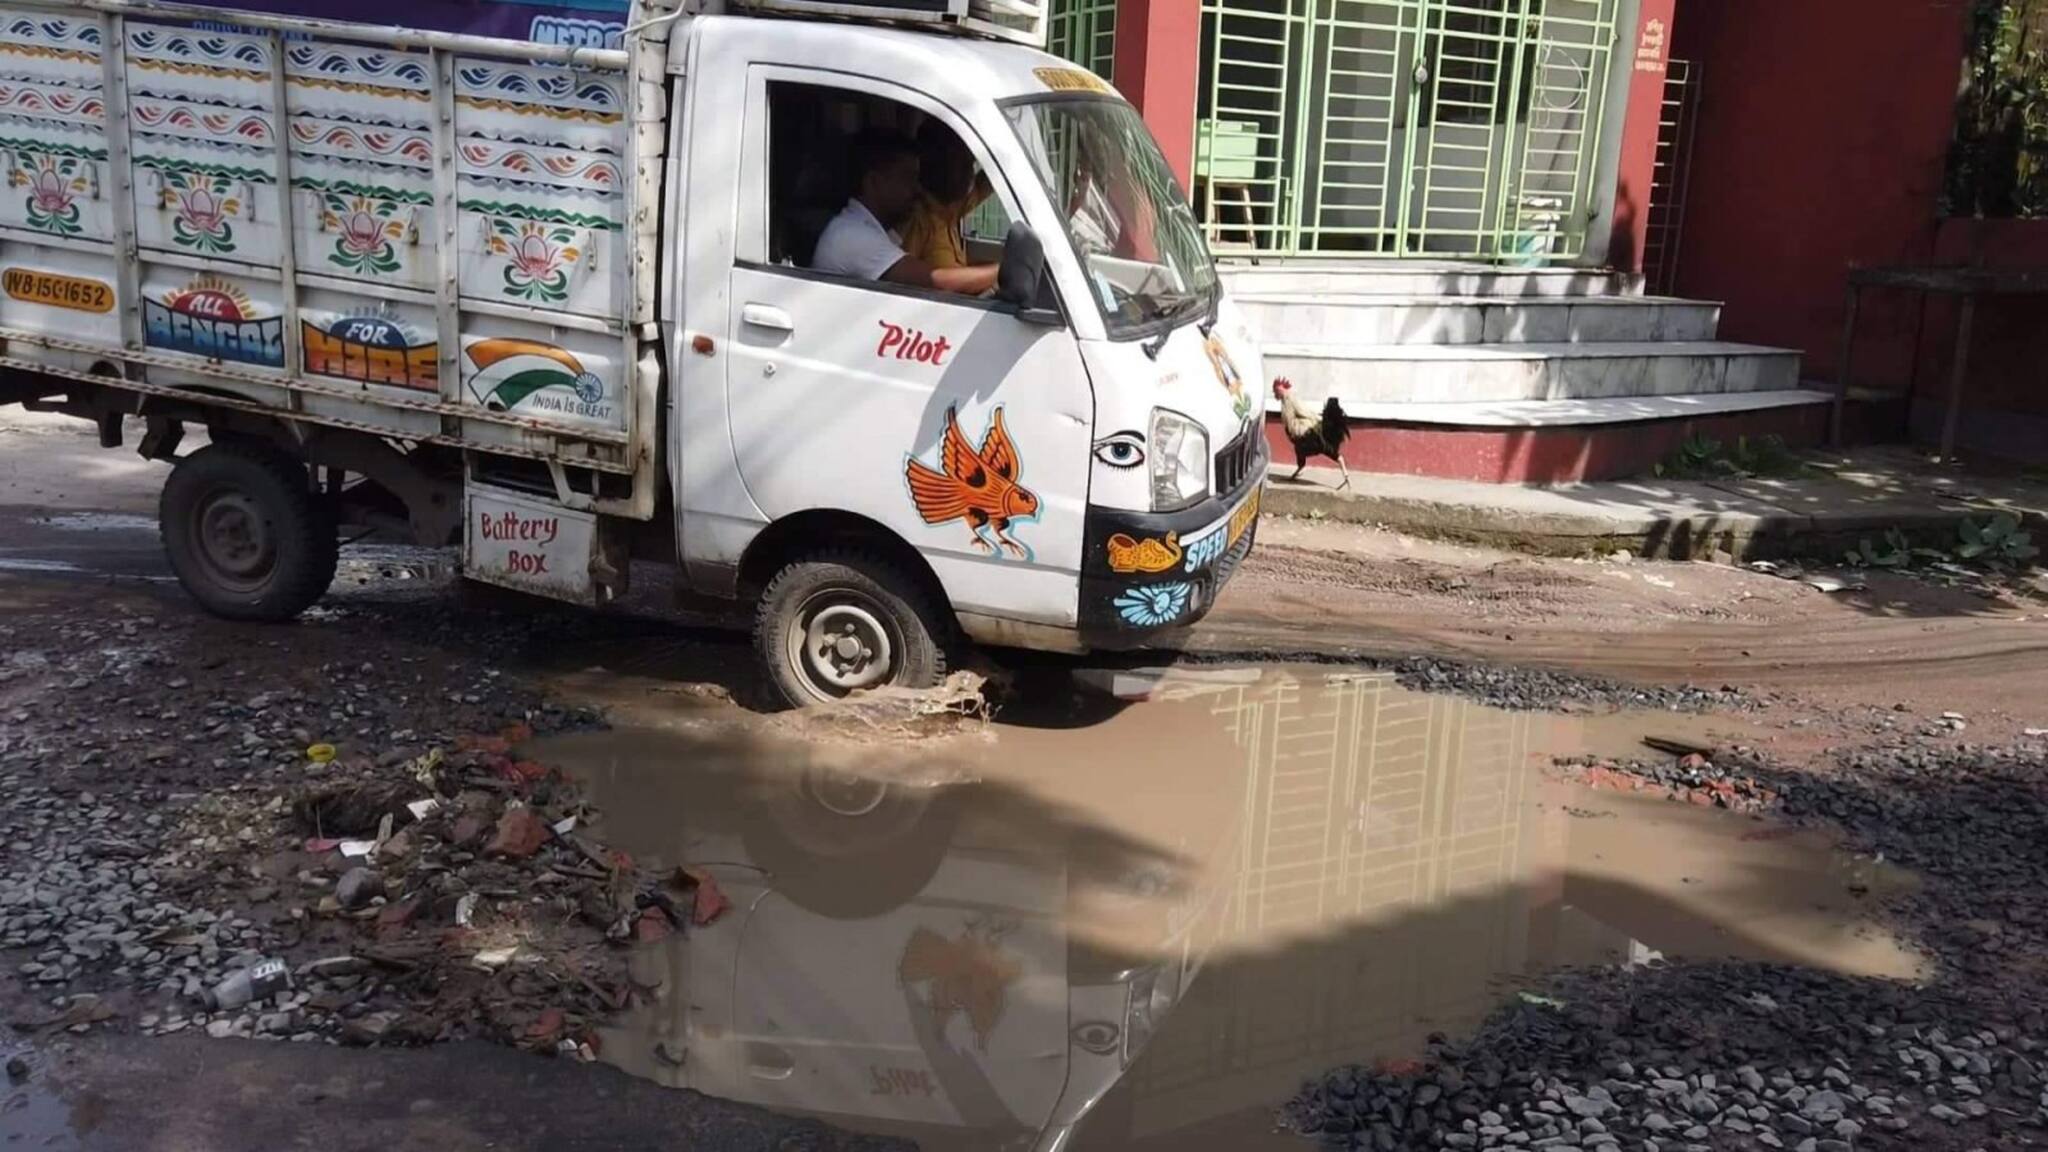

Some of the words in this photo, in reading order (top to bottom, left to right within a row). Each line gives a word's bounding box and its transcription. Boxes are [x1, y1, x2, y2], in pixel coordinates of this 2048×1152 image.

[188, 294, 223, 316] ALL
[143, 296, 285, 368] BENGAL
[345, 323, 389, 344] FOR
[877, 319, 951, 365] Pilot
[532, 393, 561, 411] INDIA
[576, 404, 612, 420] GREAT
[481, 511, 558, 548] Battery
[508, 550, 549, 575] Box
